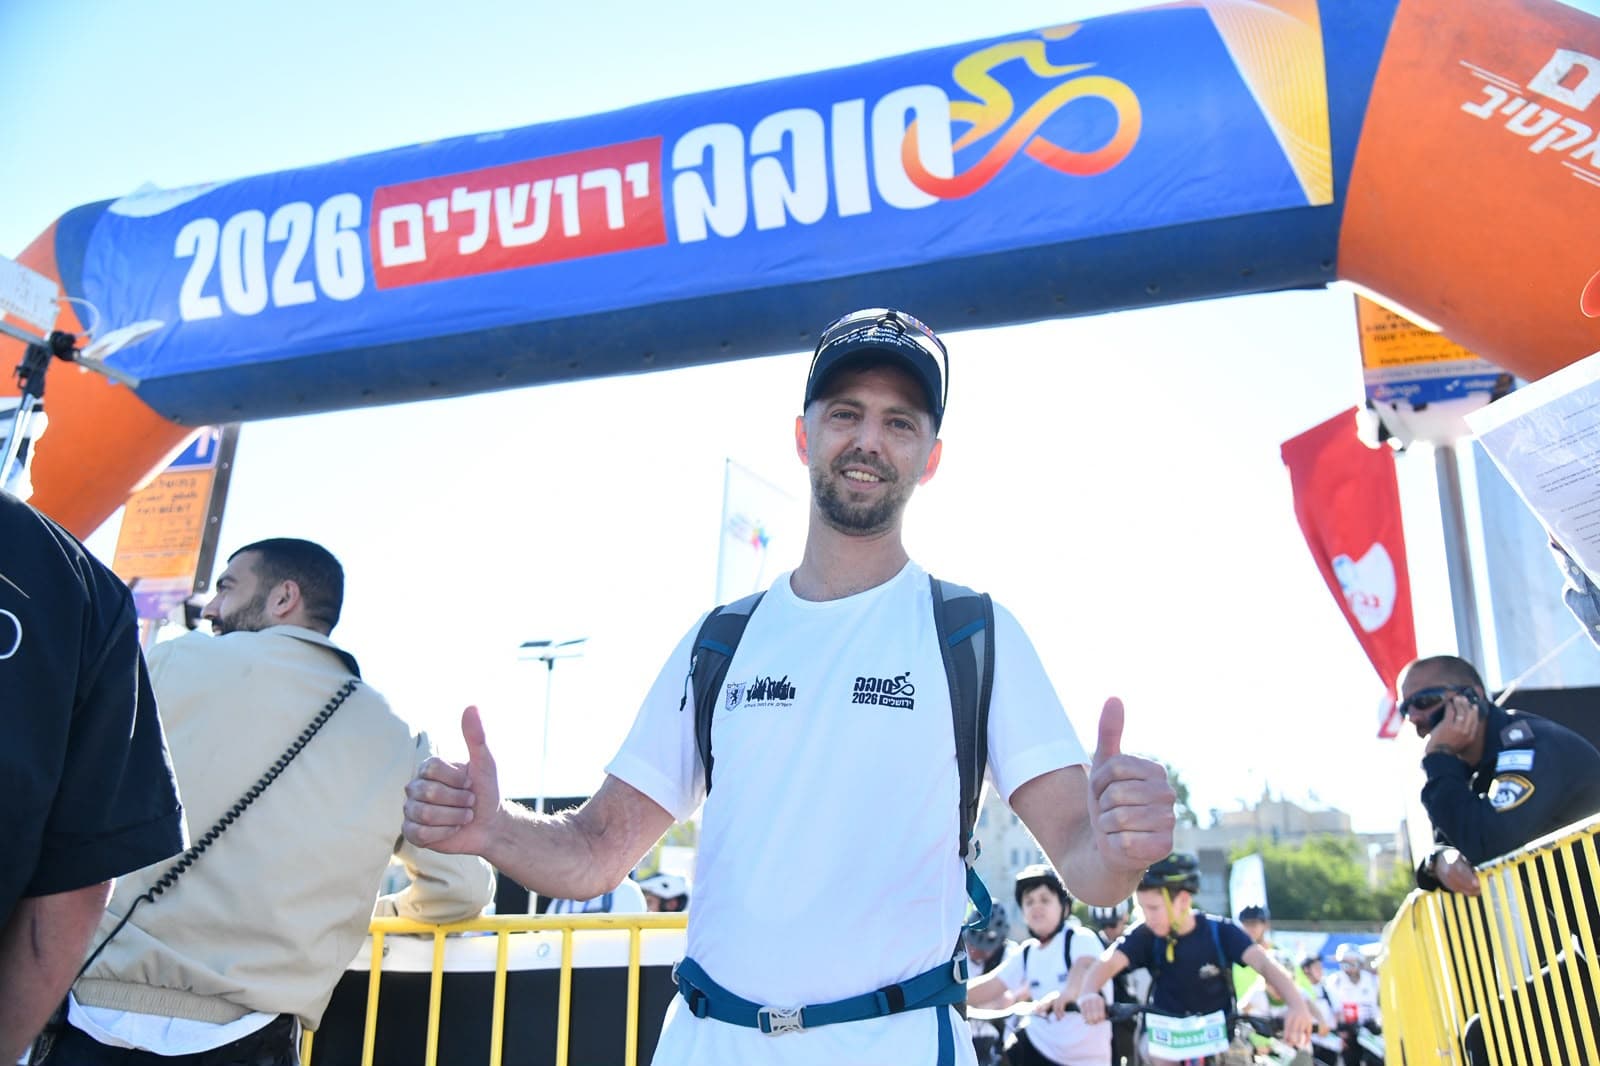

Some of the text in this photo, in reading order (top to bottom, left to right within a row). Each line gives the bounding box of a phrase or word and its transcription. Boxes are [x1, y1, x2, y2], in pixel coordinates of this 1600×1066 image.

[378, 160, 650, 268] ירושלים
[673, 84, 954, 244] סובב
[174, 191, 366, 321] 2026
[851, 692, 912, 707] ירושלים 2026
[853, 676, 893, 694] סובב
